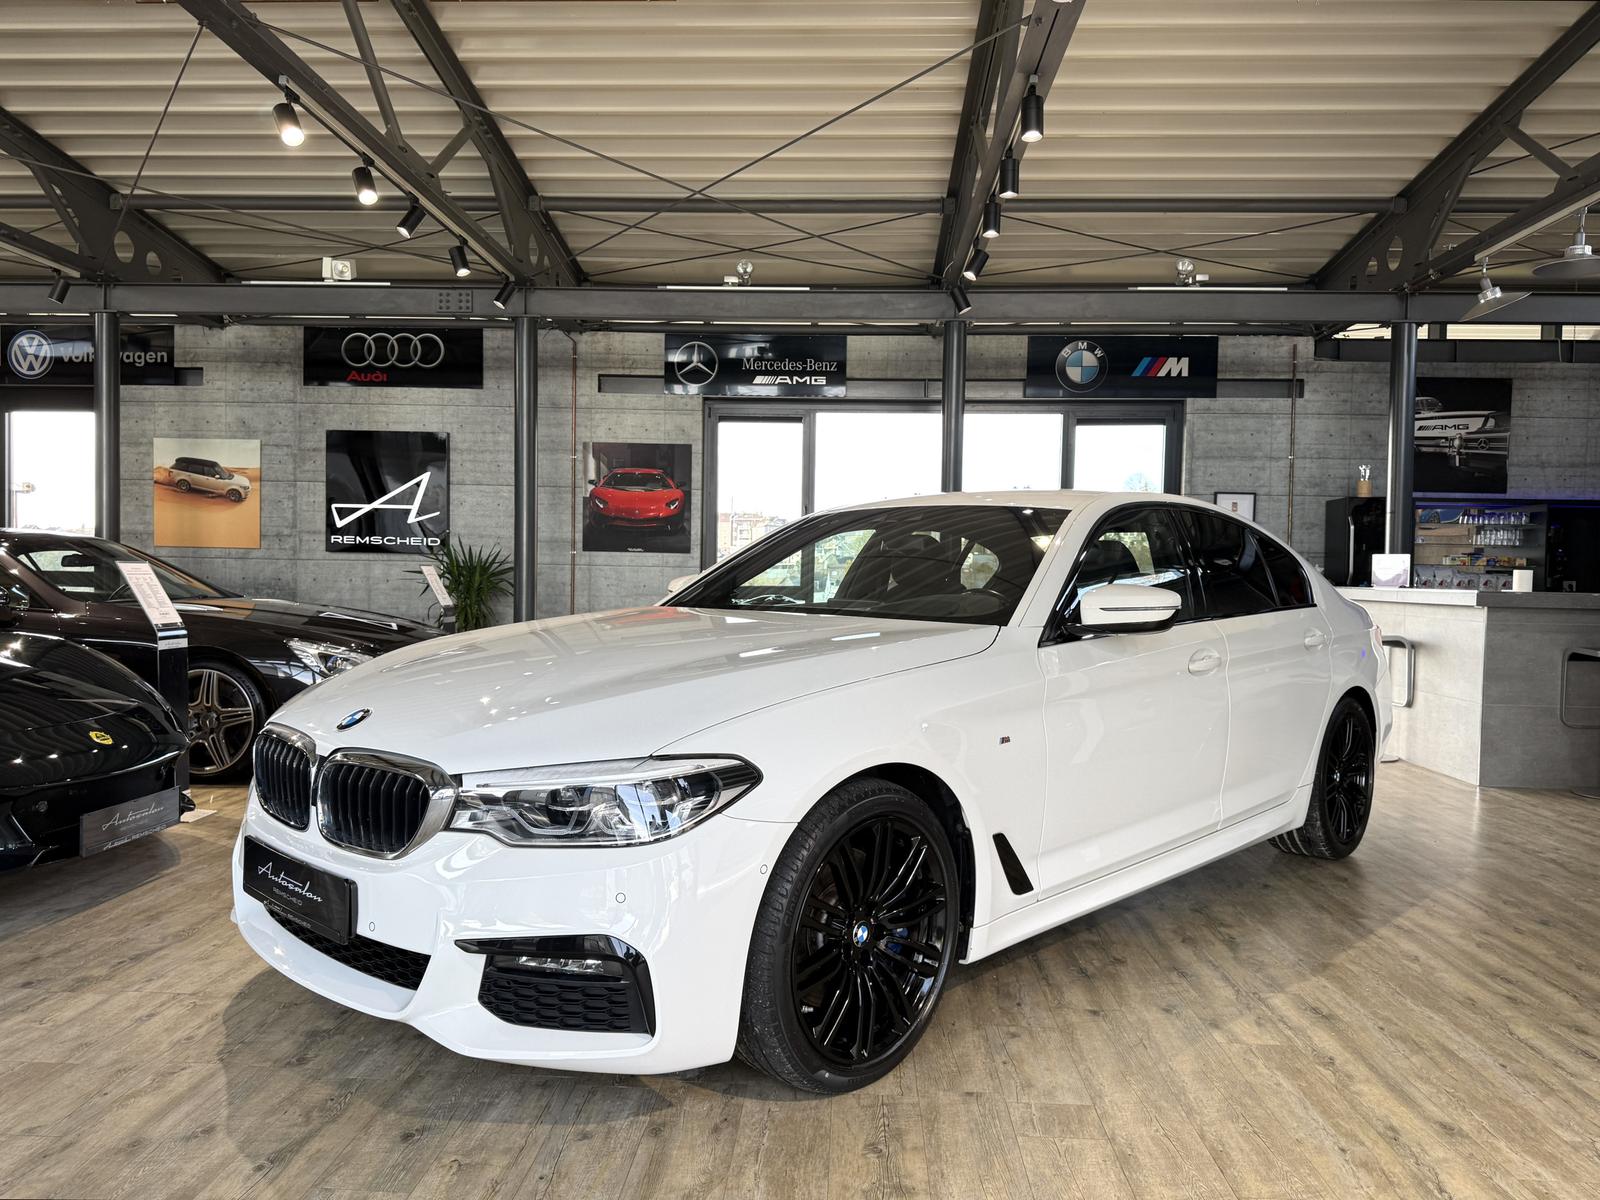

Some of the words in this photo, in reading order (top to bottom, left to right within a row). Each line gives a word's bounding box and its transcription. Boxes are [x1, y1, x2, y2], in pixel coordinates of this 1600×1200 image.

[1061, 341, 1104, 358] BMW
[60, 346, 168, 367] Volkagen
[742, 358, 838, 372] Mercedes-Benz
[346, 370, 388, 382] Audi
[774, 375, 827, 385] AMG
[1432, 423, 1470, 431] AMG
[330, 535, 441, 546] REMSCHEID
[257, 861, 323, 902] Autosalon
